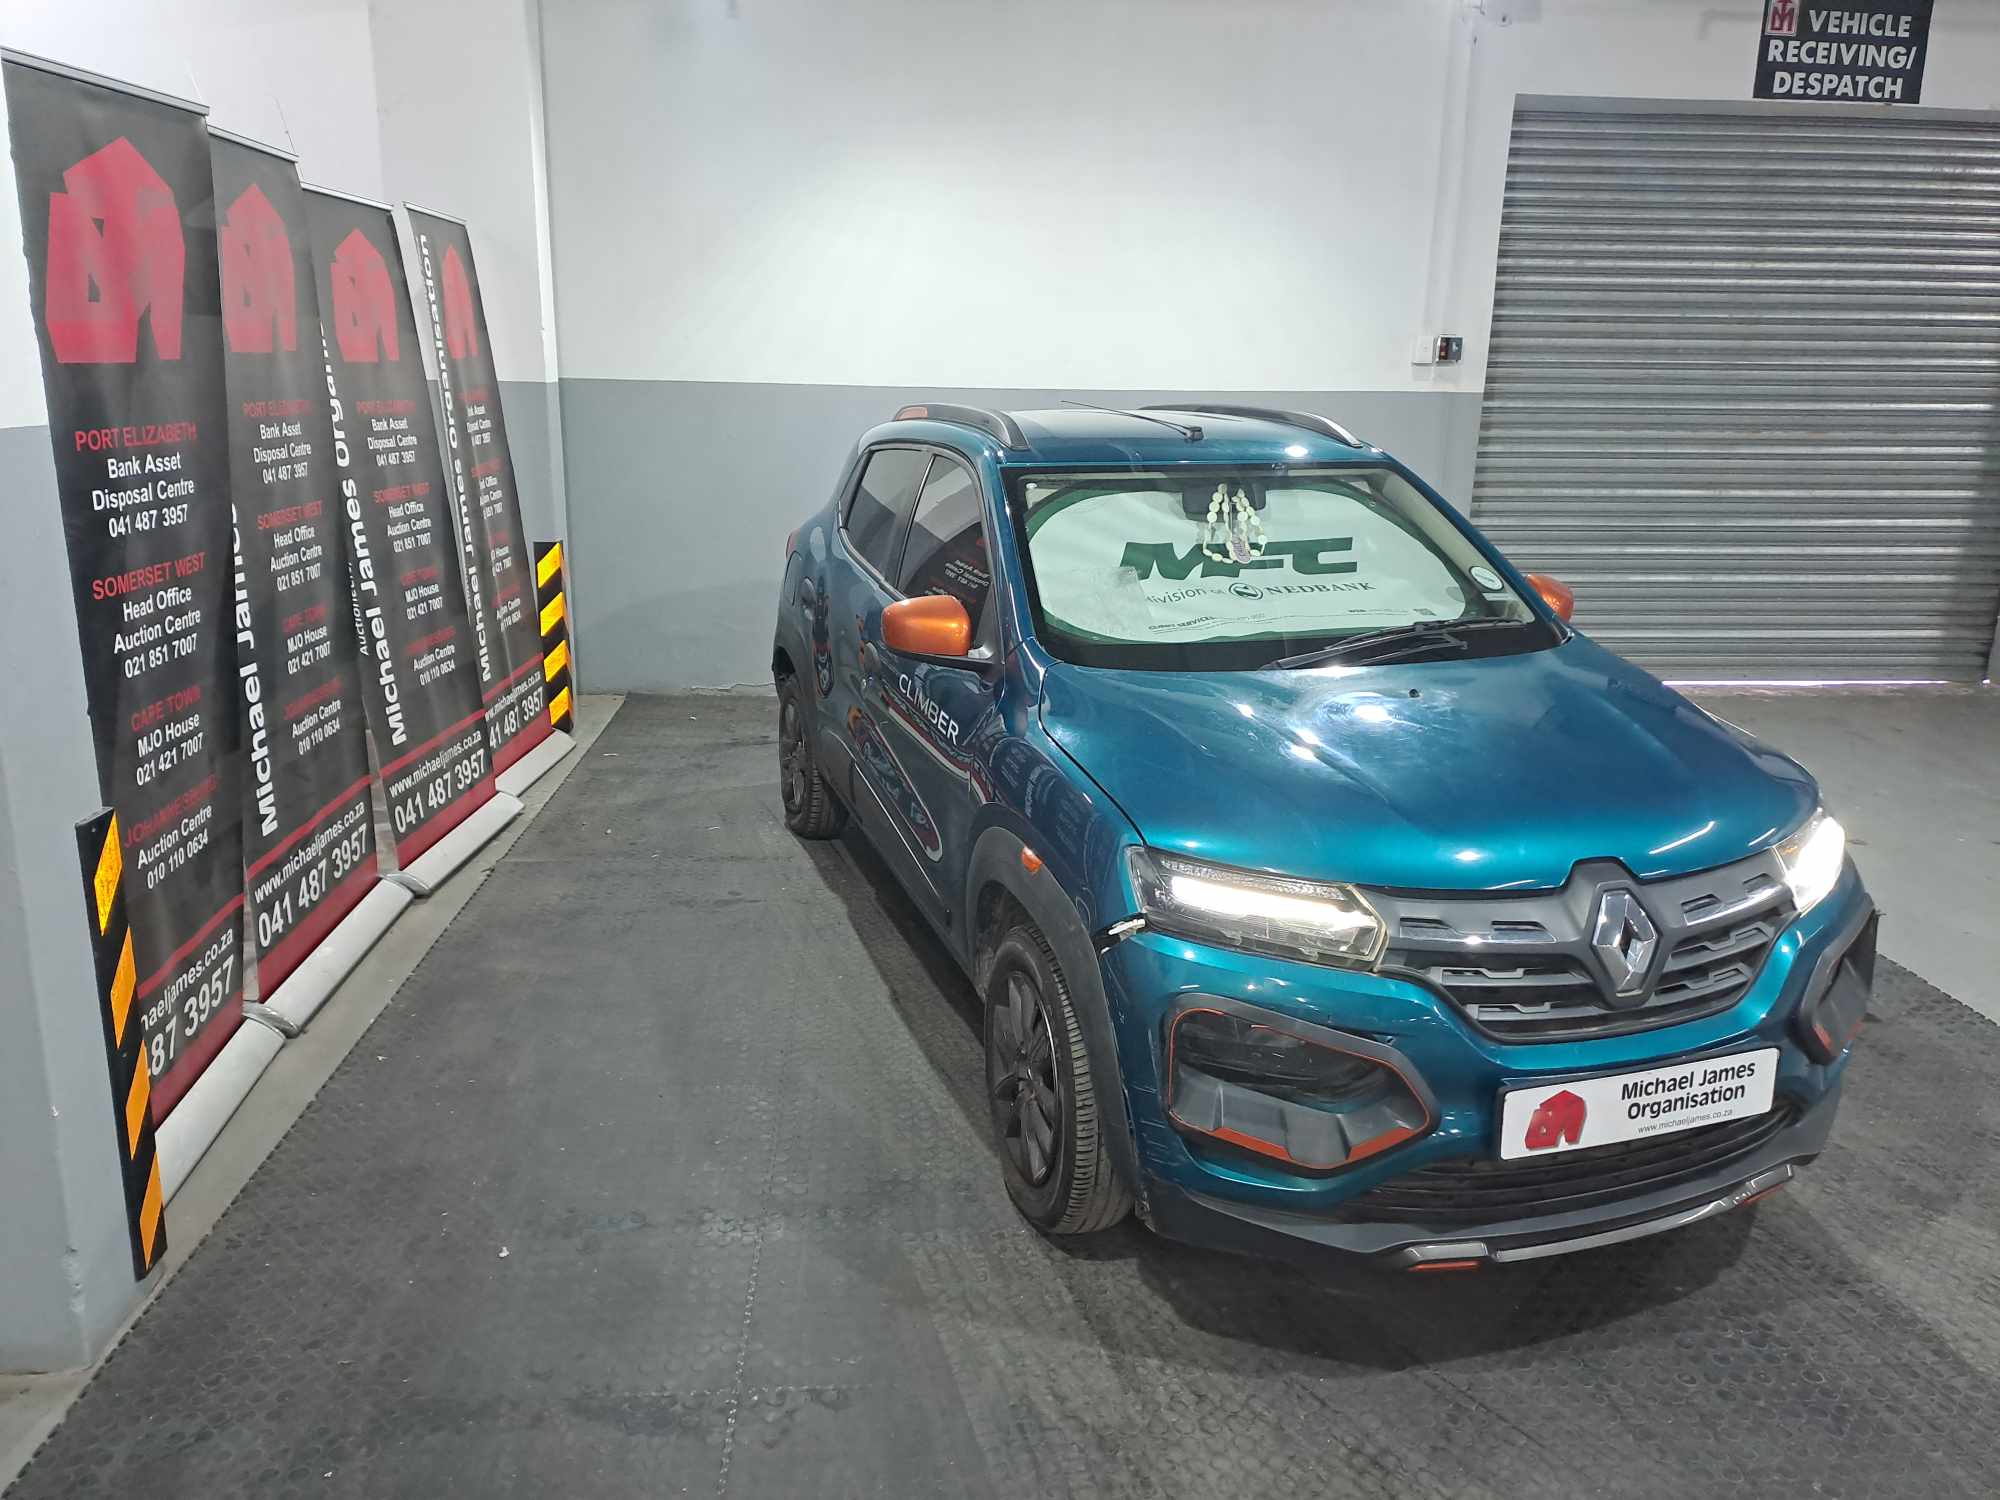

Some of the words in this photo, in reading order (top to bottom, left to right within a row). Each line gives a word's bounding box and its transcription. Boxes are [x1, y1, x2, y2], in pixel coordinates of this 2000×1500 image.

[1809, 9, 1912, 38] VEHICLE
[1767, 39, 1917, 70] RECEIVING/
[1772, 71, 1903, 99] DESPATCH
[75, 427, 119, 452] PORT
[123, 421, 197, 447] ELIZABETH
[259, 422, 281, 440] Bank
[282, 420, 303, 437] Asset
[107, 455, 141, 479] Bank
[145, 451, 182, 474] Asset
[252, 443, 289, 465] Disposal
[289, 441, 312, 458] Centre
[262, 467, 277, 485] 041
[278, 464, 292, 481] 487
[293, 462, 309, 479] 3957
[92, 481, 153, 512] Disposal
[157, 478, 195, 500] Centre
[453, 457, 475, 559] James
[108, 514, 131, 538] 041
[135, 509, 157, 532] 487
[162, 503, 188, 527] 3957
[273, 528, 294, 550] Head
[294, 524, 316, 544] Office
[342, 477, 379, 597] James
[92, 561, 172, 601] SOMERSET
[174, 552, 206, 578] WEST
[270, 551, 300, 573] Auction
[299, 544, 323, 563] Centre
[277, 573, 291, 592] 021
[291, 569, 305, 587] 851
[305, 562, 322, 582] 7007
[123, 594, 154, 622] Head
[156, 586, 192, 610] Office
[1264, 582, 1377, 595] NEDBANK
[113, 623, 162, 654] Auction
[165, 610, 201, 635] Centre
[286, 632, 304, 654] MJO
[304, 625, 329, 646] House
[467, 566, 492, 683] Michael
[124, 653, 146, 679] 021
[149, 643, 169, 669] 851
[172, 632, 198, 659] 7007
[287, 655, 301, 675] 021
[301, 648, 315, 667] 421
[314, 640, 332, 661] 7007
[365, 606, 408, 748] Michael
[131, 701, 163, 732] CAPE
[292, 712, 319, 739] Auction
[319, 699, 342, 720] Centre
[521, 685, 544, 721] 3957
[899, 673, 960, 746] CLIMBER
[137, 728, 163, 759] MJO
[165, 713, 200, 743] House
[239, 662, 280, 838] Michael
[298, 735, 311, 756] 010
[310, 728, 323, 747] 110
[323, 716, 341, 738] 0634
[136, 759, 156, 786] 021
[158, 746, 178, 772] 421
[180, 731, 204, 761] 7007
[394, 790, 425, 834] 041
[427, 770, 452, 809] 487
[454, 747, 485, 790] 3957
[137, 829, 180, 870] Auction
[180, 804, 213, 837] Centre
[254, 801, 366, 904] www.michaeljames.co.za
[147, 861, 166, 890] 010
[168, 847, 185, 873] 110
[186, 827, 208, 858] 0634
[258, 890, 293, 948] 041
[298, 857, 328, 909] 487
[331, 822, 368, 879] 3957
[149, 1015, 177, 1077] 87
[184, 953, 235, 1037] 3957
[1621, 1071, 1695, 1101] Michael
[1698, 1062, 1756, 1086] James
[1627, 1084, 1746, 1120] Organisation
